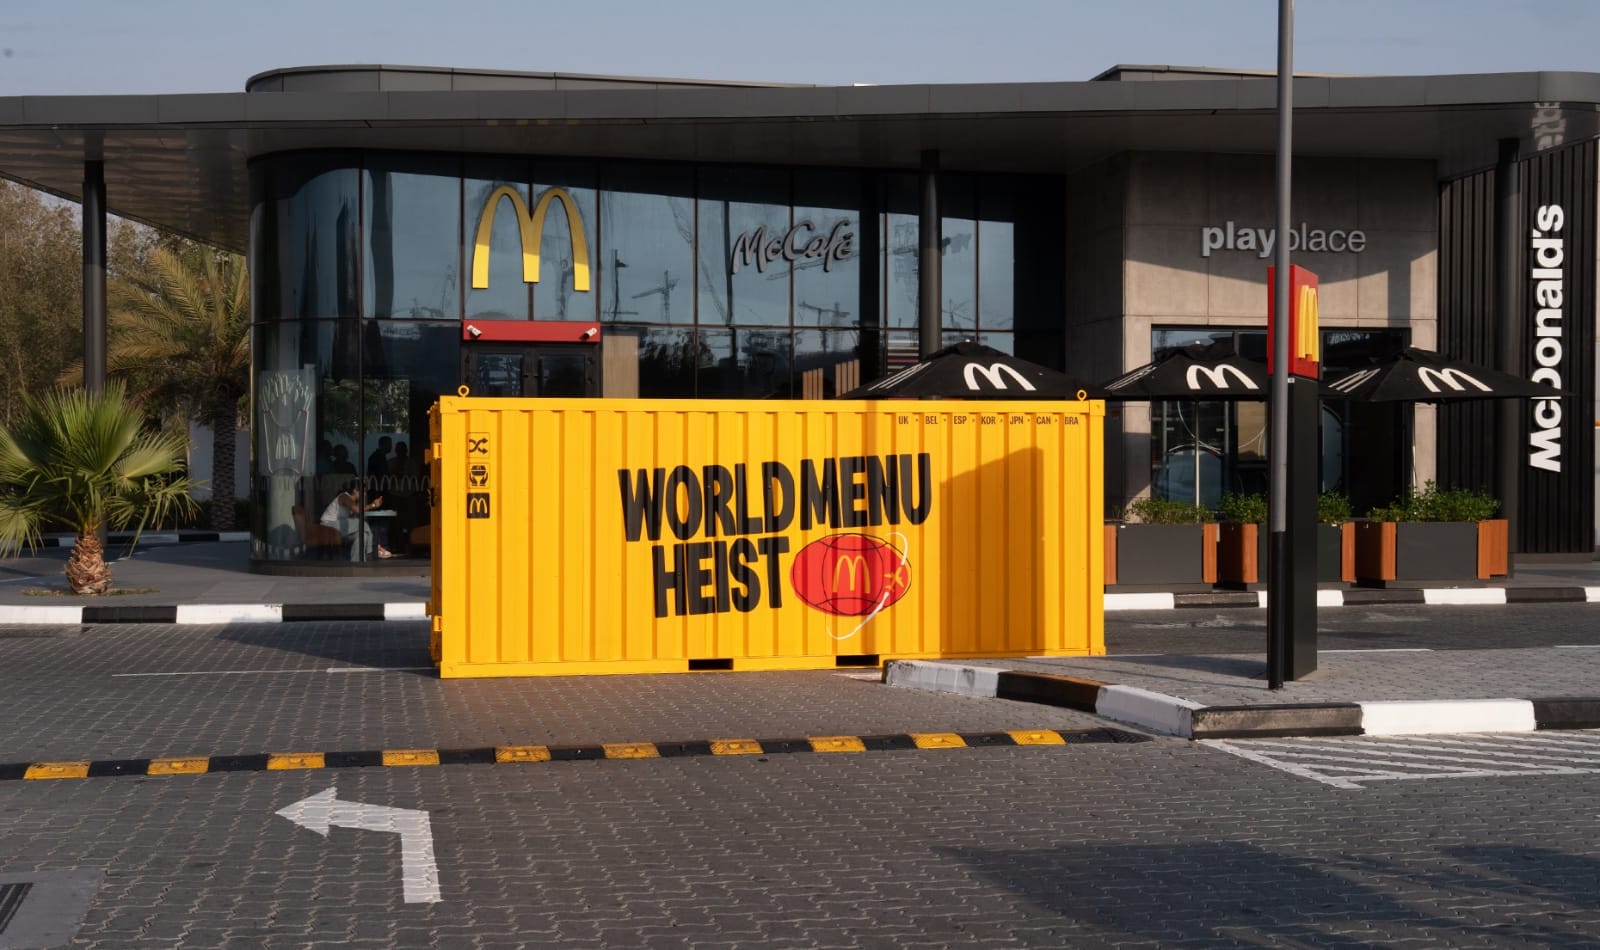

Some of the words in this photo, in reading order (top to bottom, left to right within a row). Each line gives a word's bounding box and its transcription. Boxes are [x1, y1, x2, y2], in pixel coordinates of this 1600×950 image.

[732, 219, 853, 275] McCafé
[1530, 204, 1564, 472] McDonald's
[898, 416, 909, 425] UK
[925, 416, 938, 425] BEL
[953, 416, 967, 425] ESP
[981, 416, 996, 425] KOR
[1009, 416, 1024, 425] JPN
[1036, 416, 1051, 425] CAN
[1064, 416, 1079, 425] BRA
[618, 461, 795, 543] WORLD
[800, 453, 932, 531] MENU
[652, 536, 790, 617] HEIST
